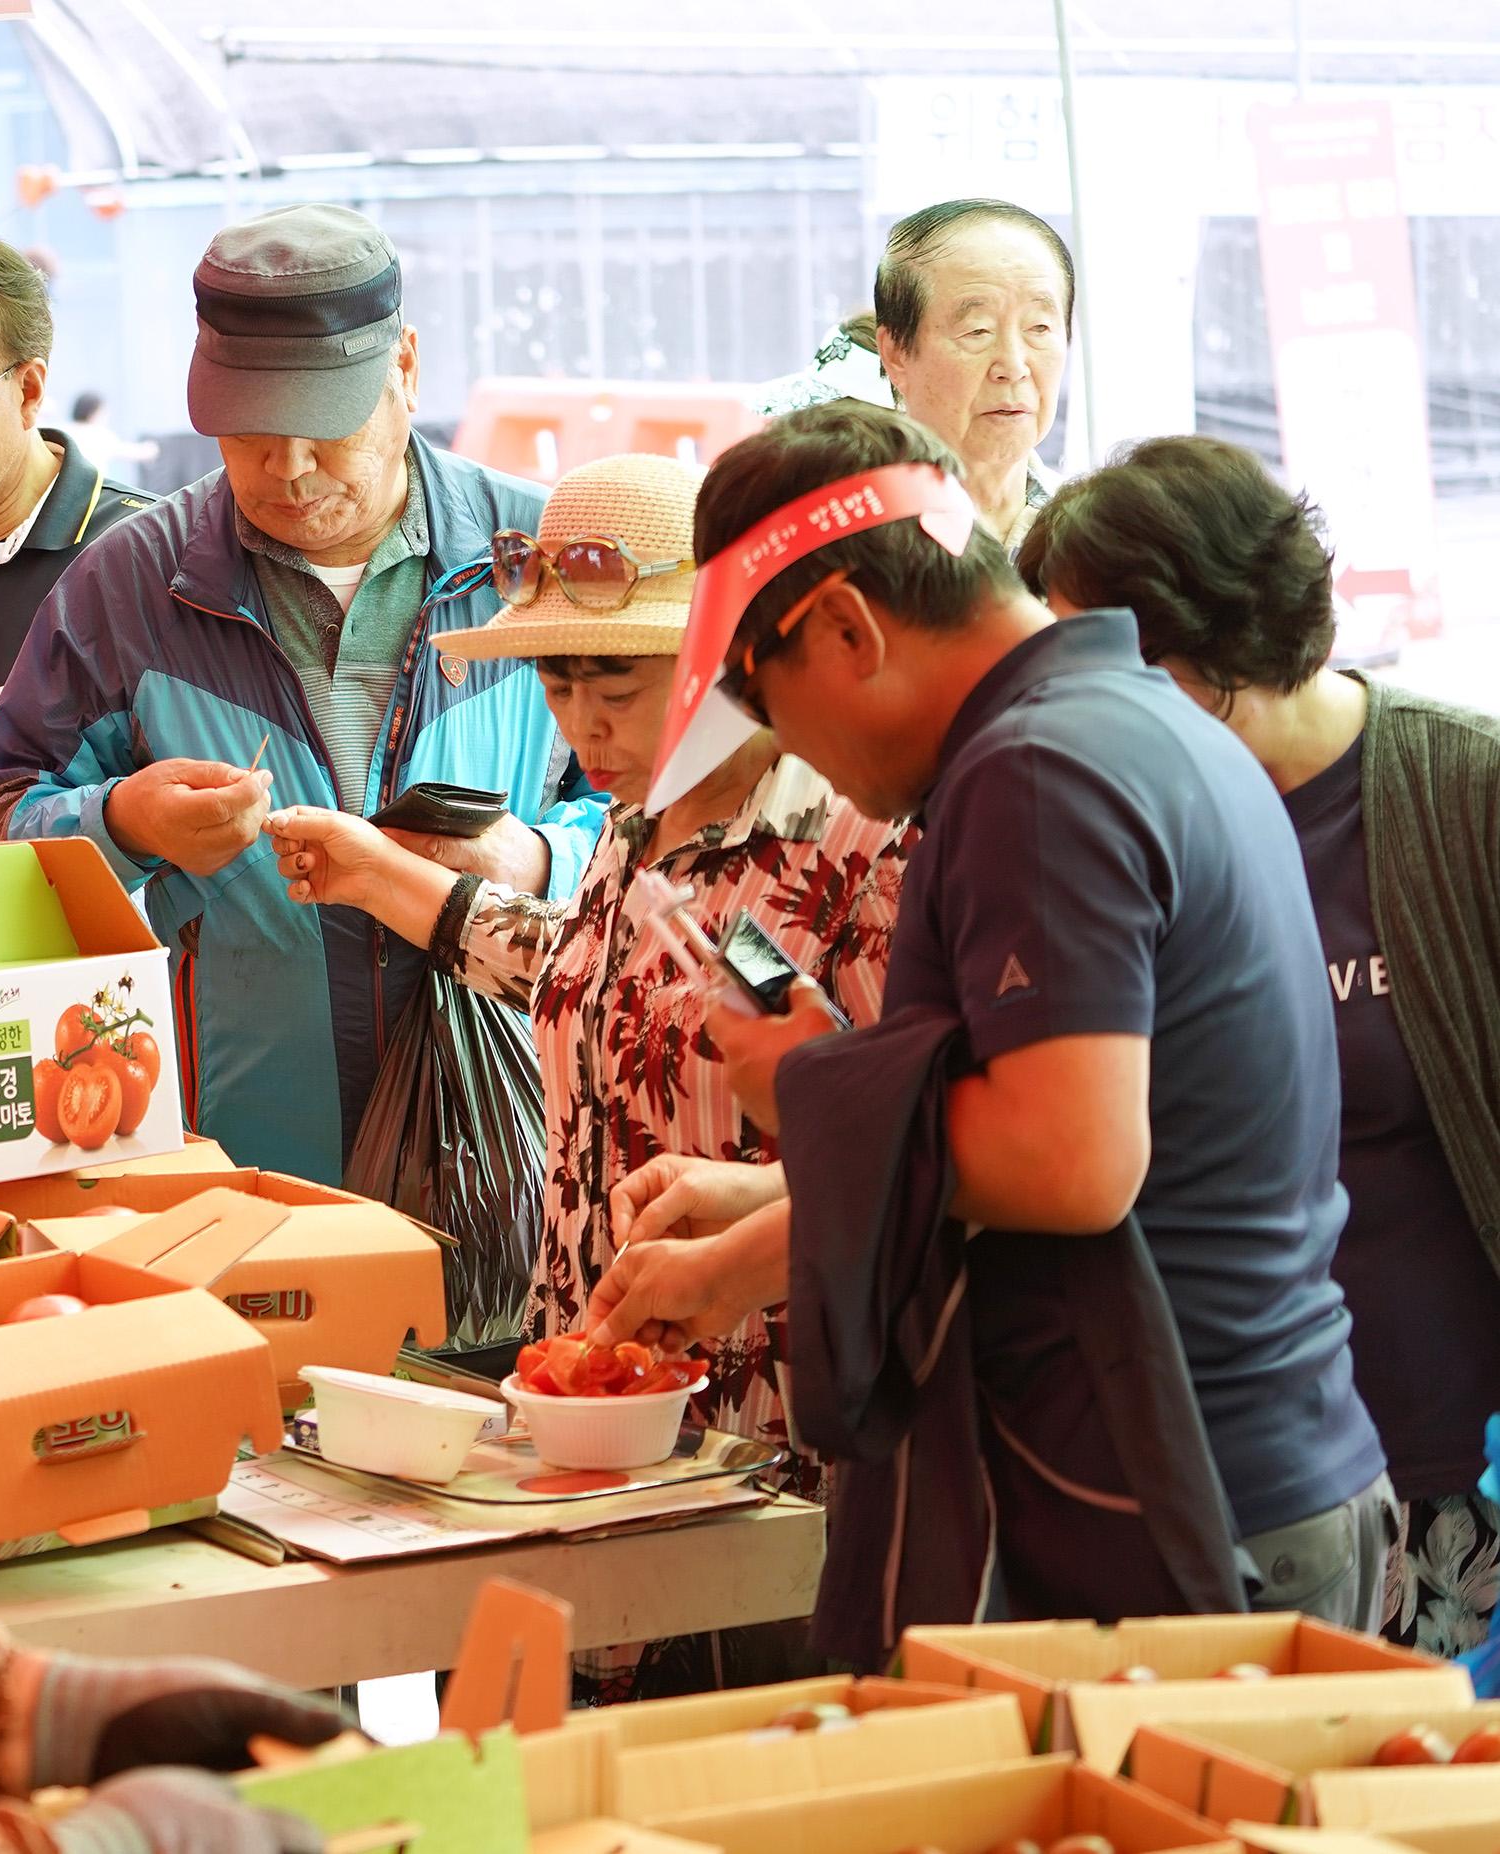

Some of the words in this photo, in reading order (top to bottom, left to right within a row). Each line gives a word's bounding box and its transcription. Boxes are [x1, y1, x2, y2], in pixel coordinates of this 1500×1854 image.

[740, 523, 798, 579] 토마토가
[807, 484, 885, 532] 방울방울
[388, 706, 405, 750] SUPREME
